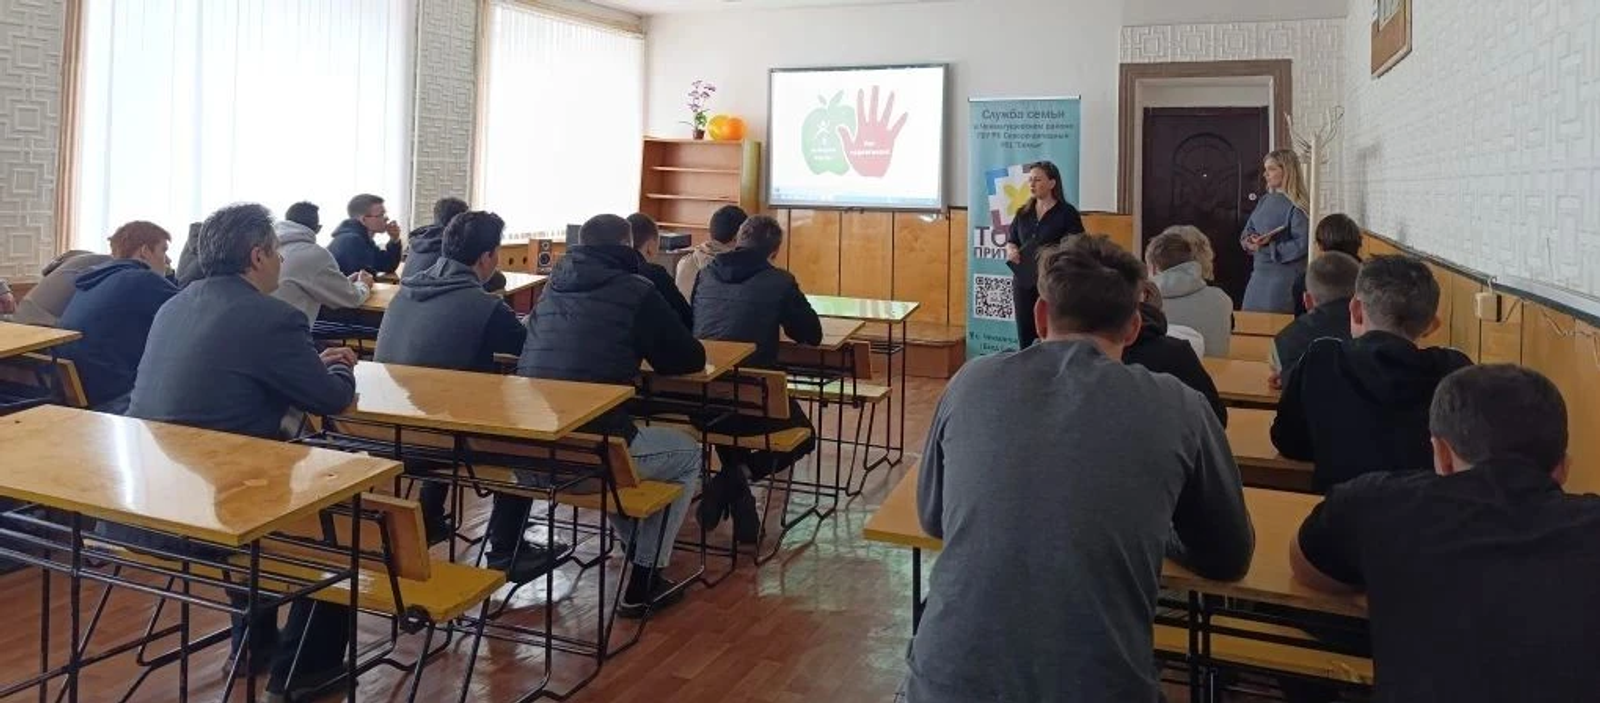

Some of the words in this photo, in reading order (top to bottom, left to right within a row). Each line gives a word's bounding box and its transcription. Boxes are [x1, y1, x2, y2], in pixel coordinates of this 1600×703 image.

[981, 109, 1024, 121] Служба
[1027, 110, 1066, 119] семьи
[974, 226, 1009, 248] ТО
